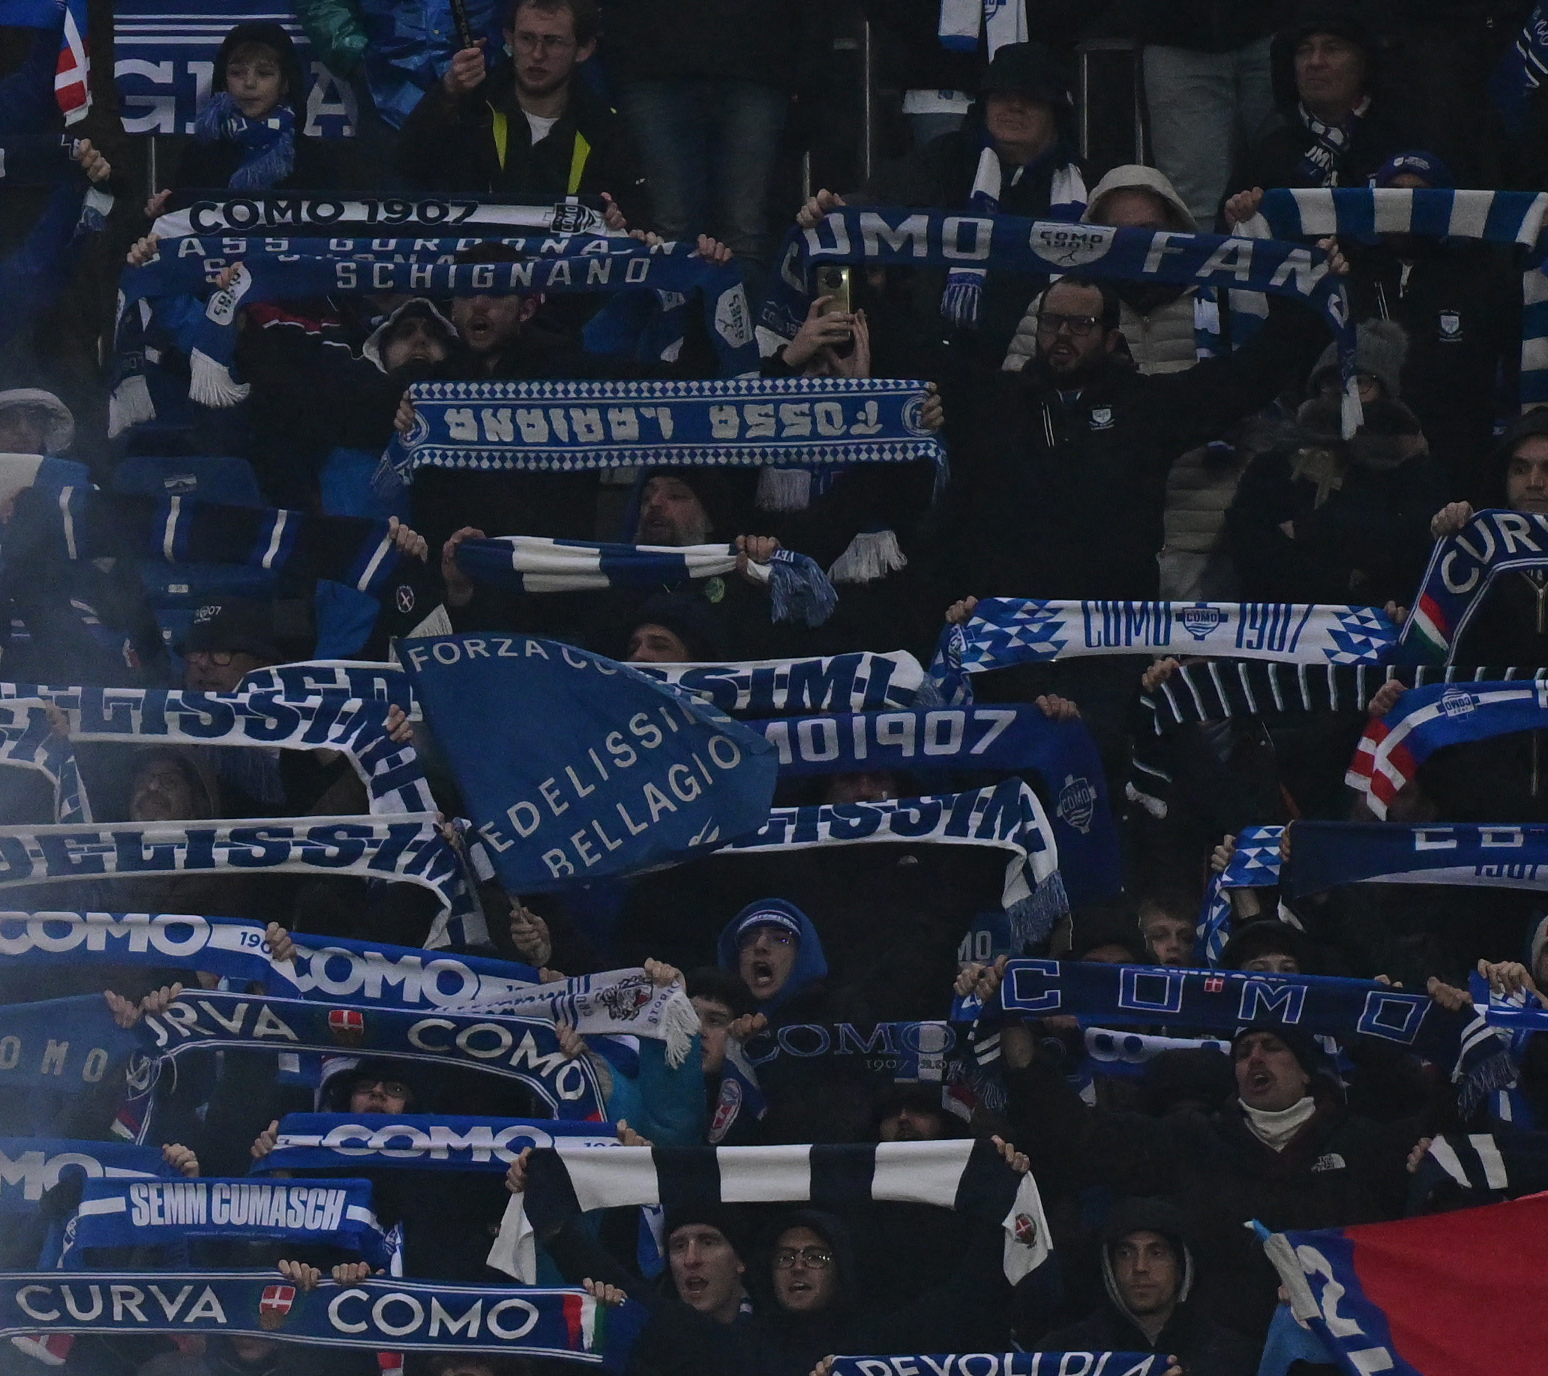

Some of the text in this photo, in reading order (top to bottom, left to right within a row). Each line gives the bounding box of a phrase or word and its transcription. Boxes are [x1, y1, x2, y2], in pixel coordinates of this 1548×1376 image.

[189, 200, 480, 236] COMO 1907
[1084, 602, 1313, 654] COMO 1907
[407, 638, 549, 673] FORZA
[542, 733, 736, 882] BELLAGIO
[272, 943, 482, 1006] COMO
[408, 1017, 588, 1102] COMO
[319, 1121, 556, 1166] COMO
[130, 1183, 347, 1231] SEMM CUMASCH
[15, 1284, 540, 1340] CURVA COMO
